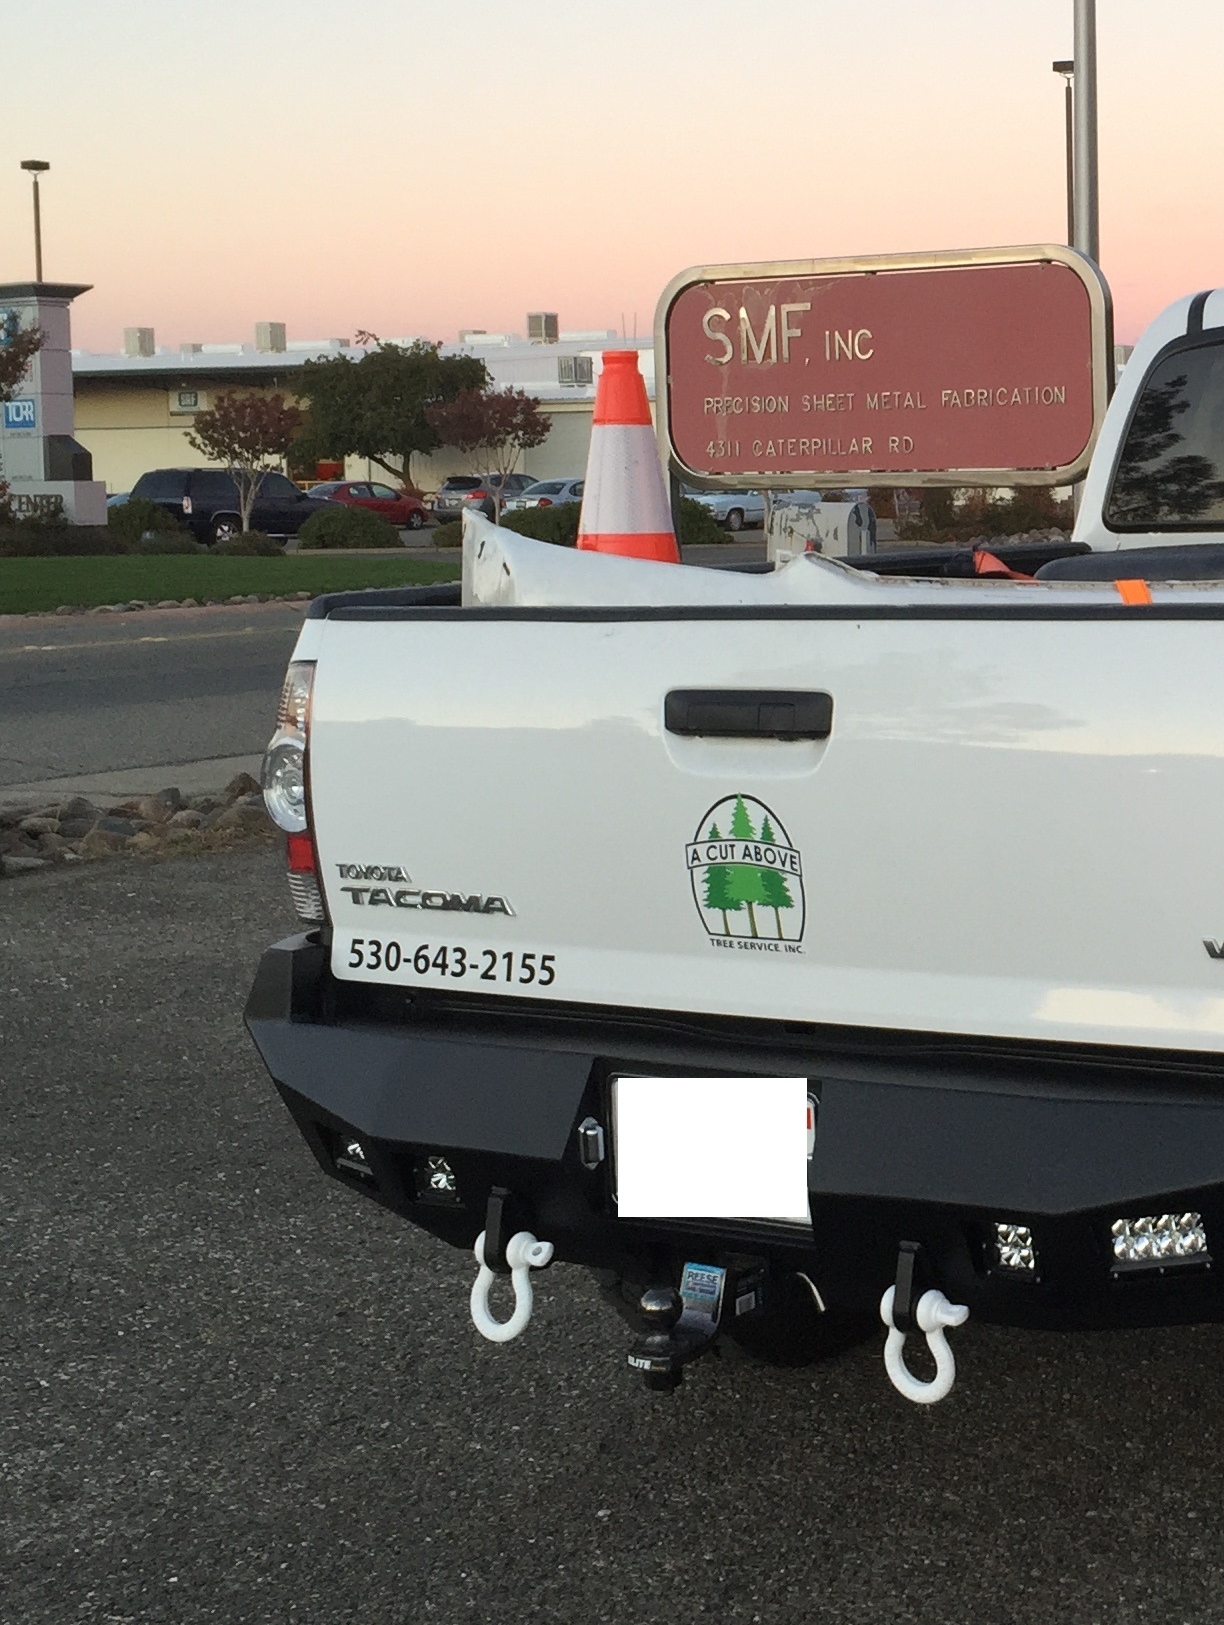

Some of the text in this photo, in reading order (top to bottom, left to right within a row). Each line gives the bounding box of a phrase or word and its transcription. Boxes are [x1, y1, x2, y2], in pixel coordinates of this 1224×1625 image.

[825, 329, 874, 361] INC
[703, 386, 1066, 415] PRECISION SHEET METAL FABRICATION
[705, 435, 915, 458] 4311 CATERPILLAR RD
[691, 844, 799, 872] A CUT ABOVE
[336, 863, 412, 883] TOYOTA
[341, 887, 517, 916] TACOMA
[710, 938, 735, 949] TREE
[348, 938, 556, 986] 530-643-2155
[688, 1271, 719, 1284] REESE
